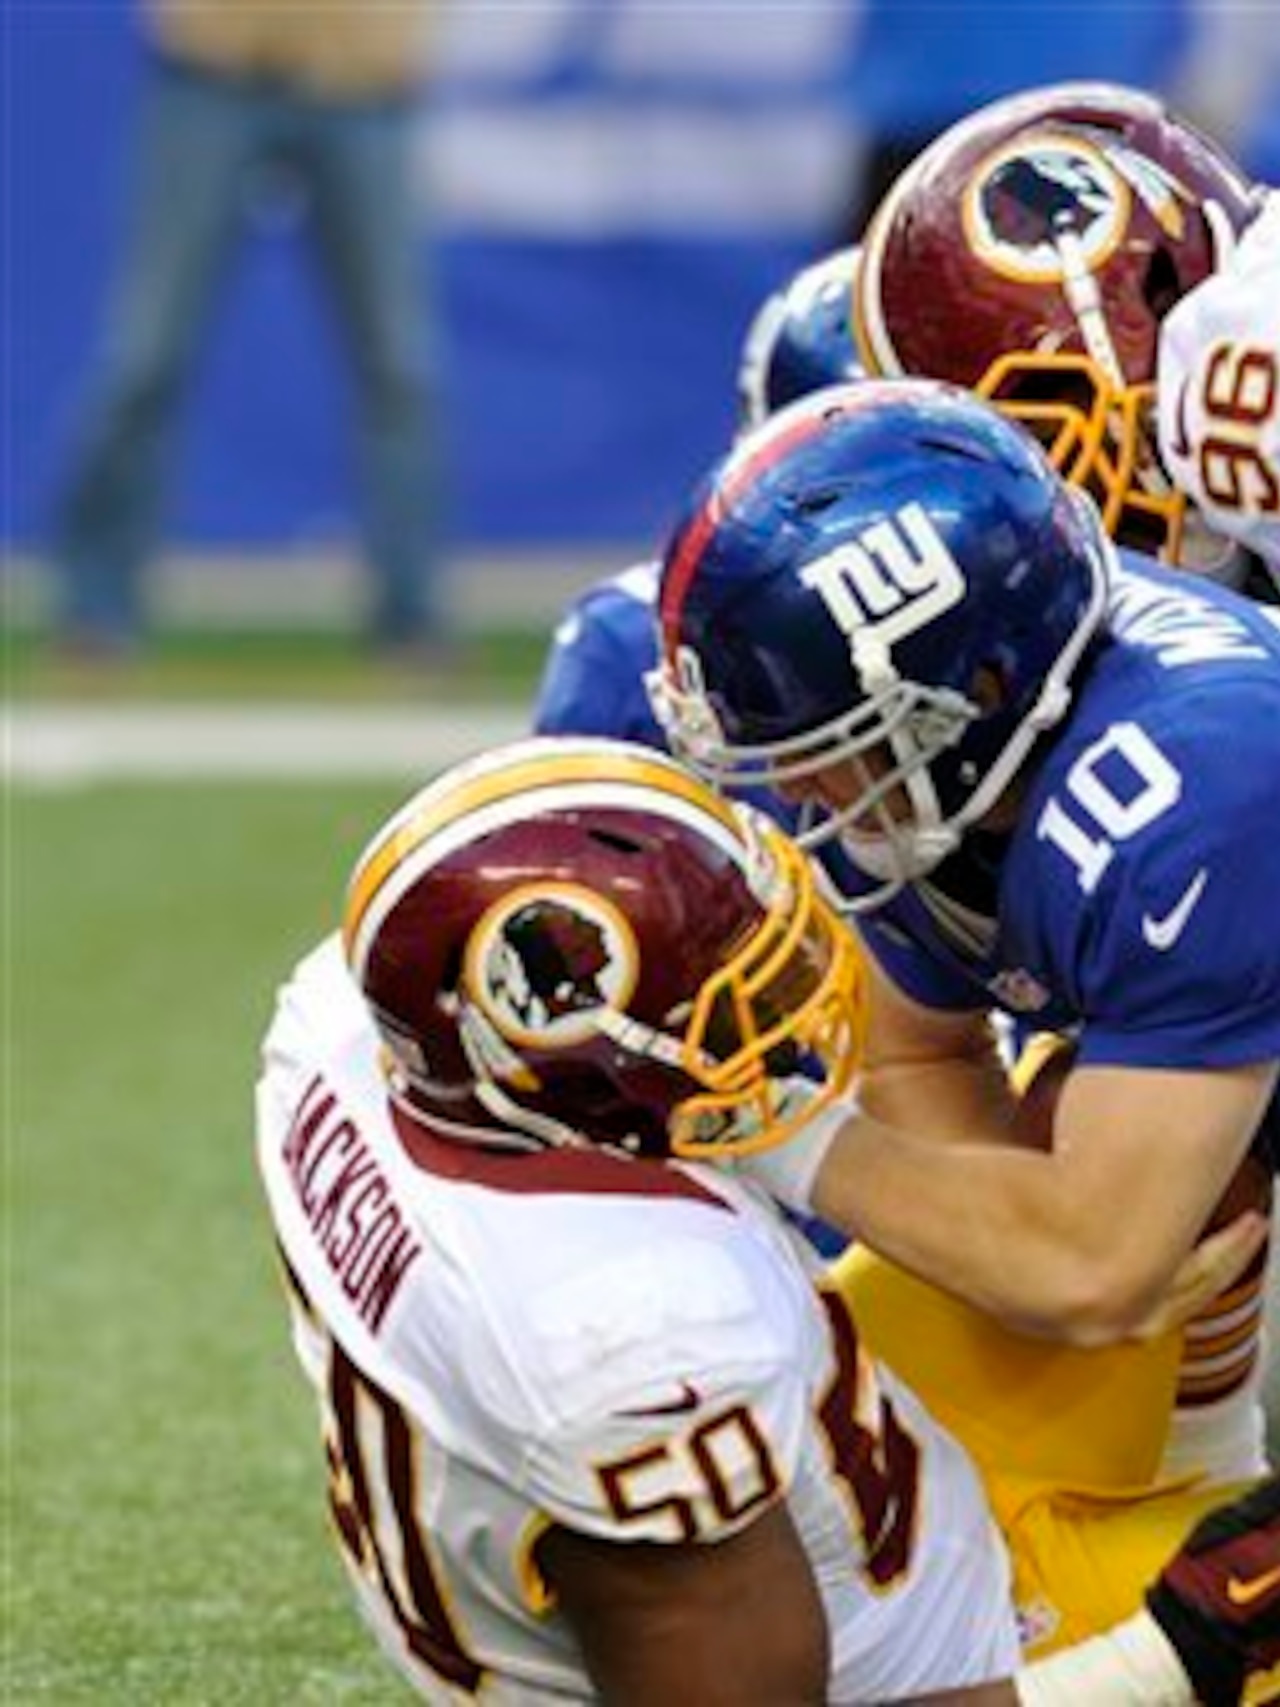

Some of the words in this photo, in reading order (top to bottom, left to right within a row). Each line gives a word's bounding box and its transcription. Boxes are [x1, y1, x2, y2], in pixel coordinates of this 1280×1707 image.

[1036, 721, 1184, 897] 10
[281, 1073, 422, 1338] JACKSON
[592, 1402, 785, 1542] 50
